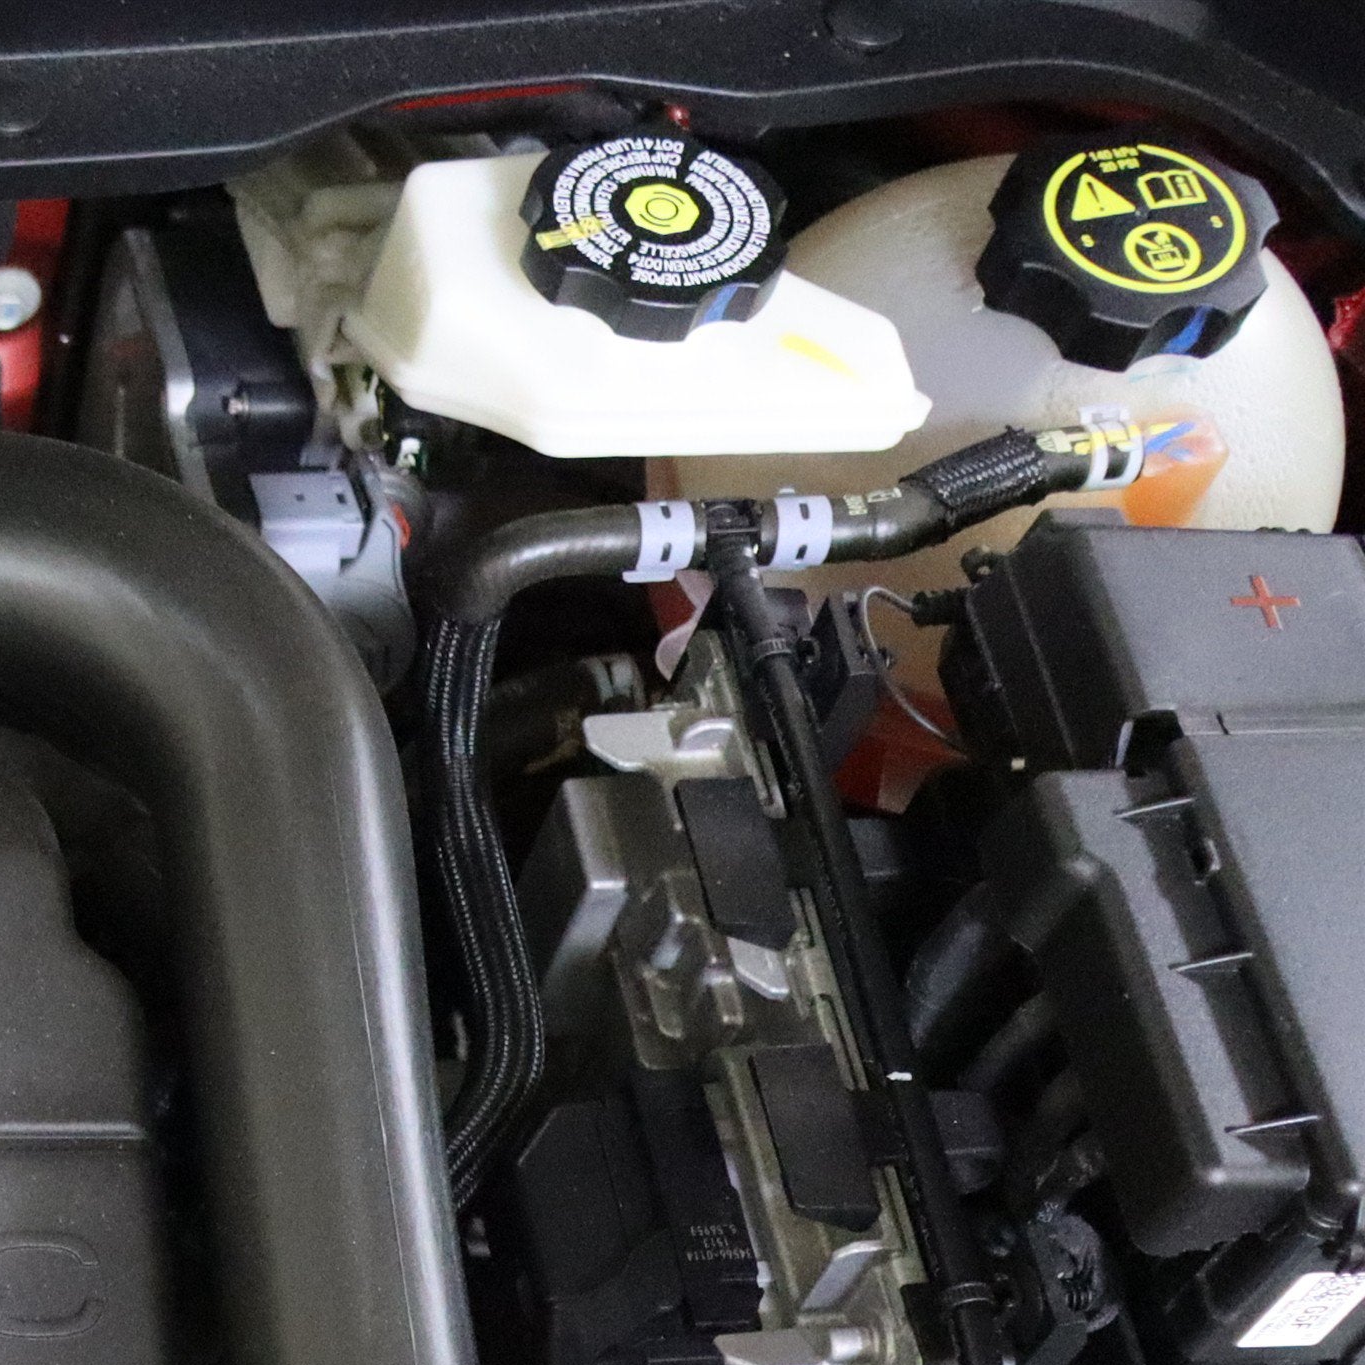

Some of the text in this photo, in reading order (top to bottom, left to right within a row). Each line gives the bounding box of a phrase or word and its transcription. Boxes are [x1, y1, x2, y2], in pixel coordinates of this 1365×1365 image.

[603, 138, 644, 155] FLUID
[643, 138, 653, 149] 4
[654, 139, 684, 154] DOT
[570, 147, 606, 172] FROM
[598, 150, 651, 173] BEFORE
[651, 151, 681, 166] CAP
[1089, 149, 1112, 163] 140
[563, 167, 579, 177] A
[553, 174, 576, 212] SEALED
[594, 180, 618, 211] CLEAN
[588, 231, 623, 255] ONLY
[636, 256, 663, 271] DOT
[664, 258, 700, 272] FREIN
[696, 254, 717, 268] DE
[716, 243, 762, 277] BOUCHON
[683, 268, 721, 286] AVANT
